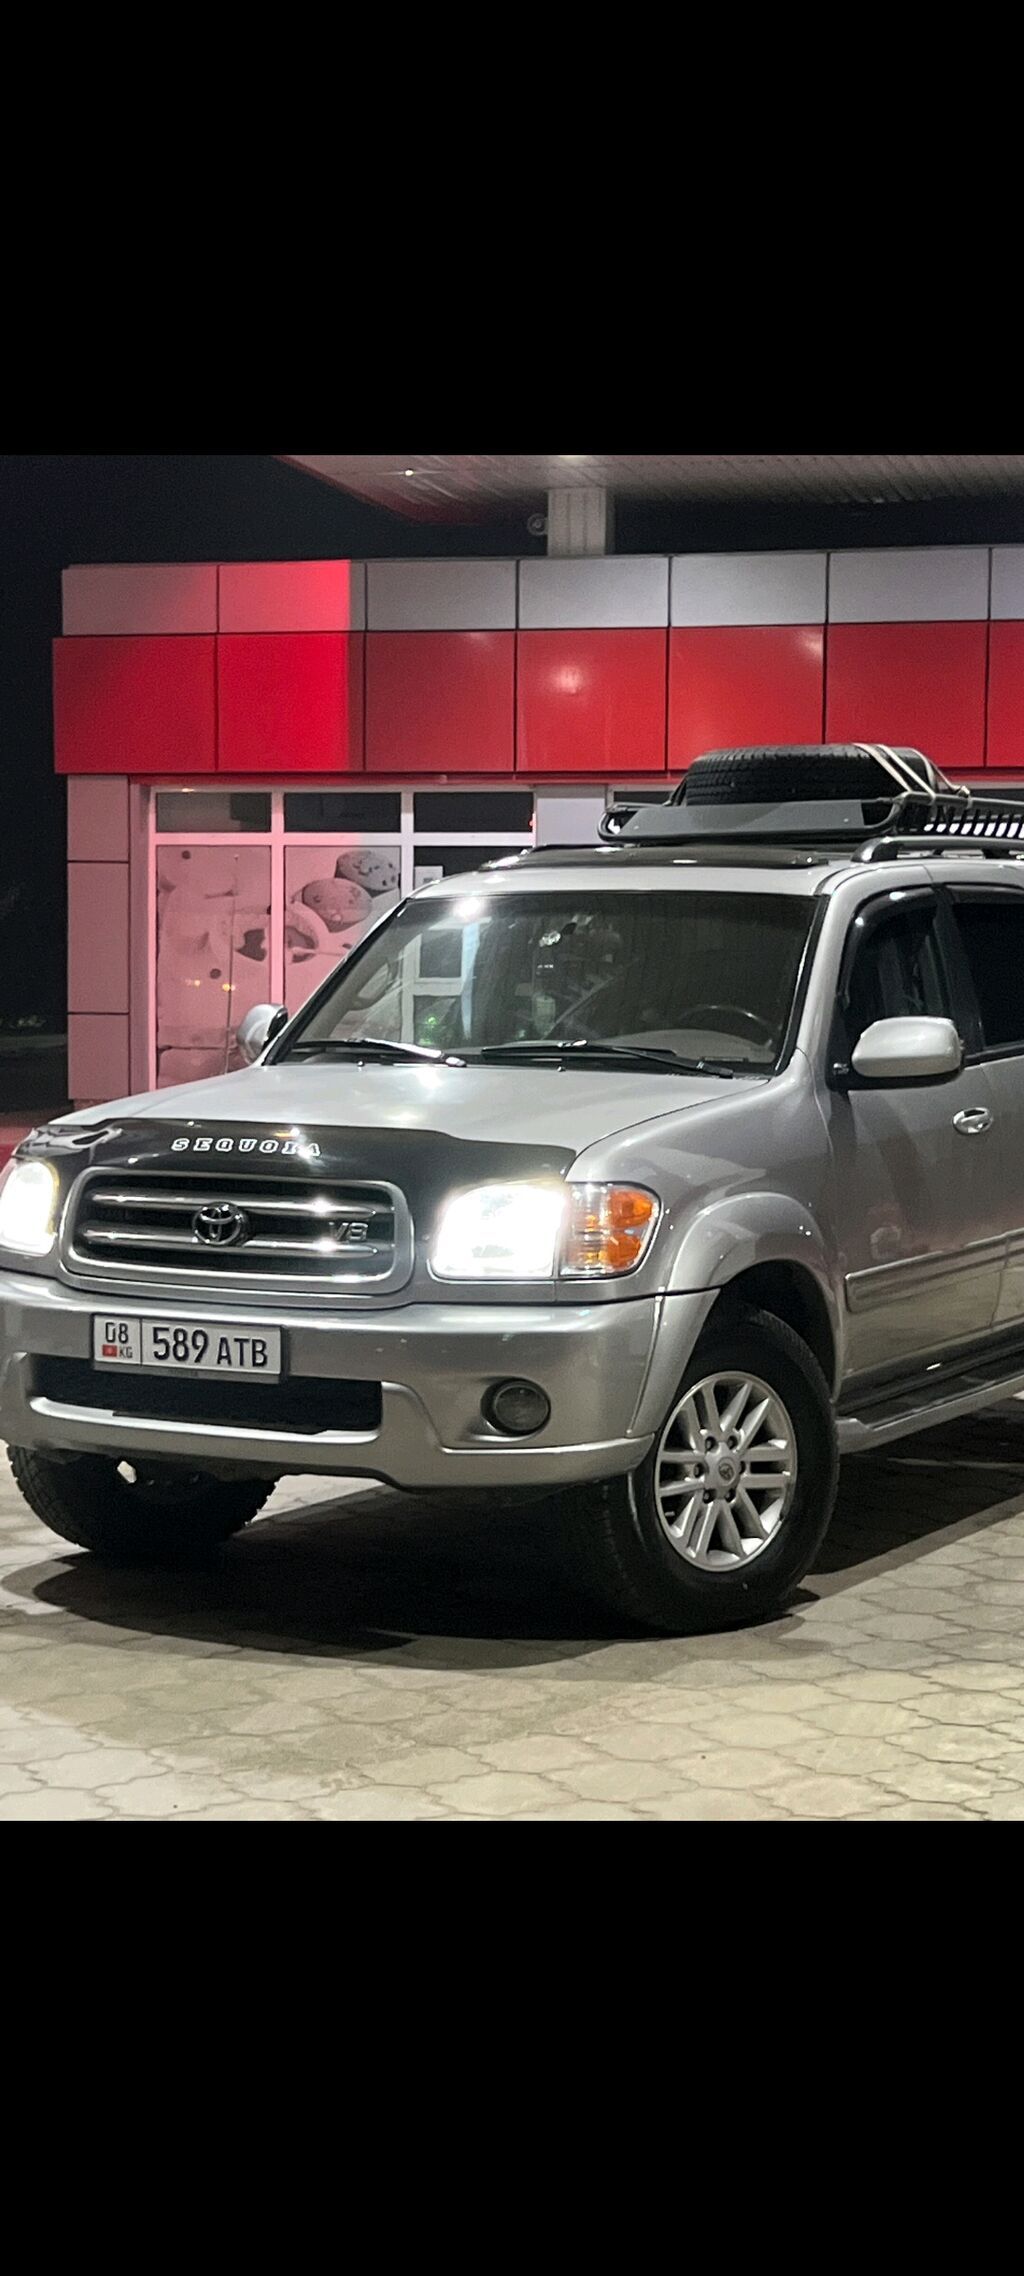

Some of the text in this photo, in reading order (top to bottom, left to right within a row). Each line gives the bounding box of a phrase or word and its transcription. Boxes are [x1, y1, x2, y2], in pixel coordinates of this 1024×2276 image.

[171, 1138, 321, 1157] SEQUOIA
[328, 1221, 369, 1241] V8
[104, 1321, 129, 1344] 08
[118, 1346, 133, 1359] KG
[152, 1326, 268, 1368] 589 ATB
